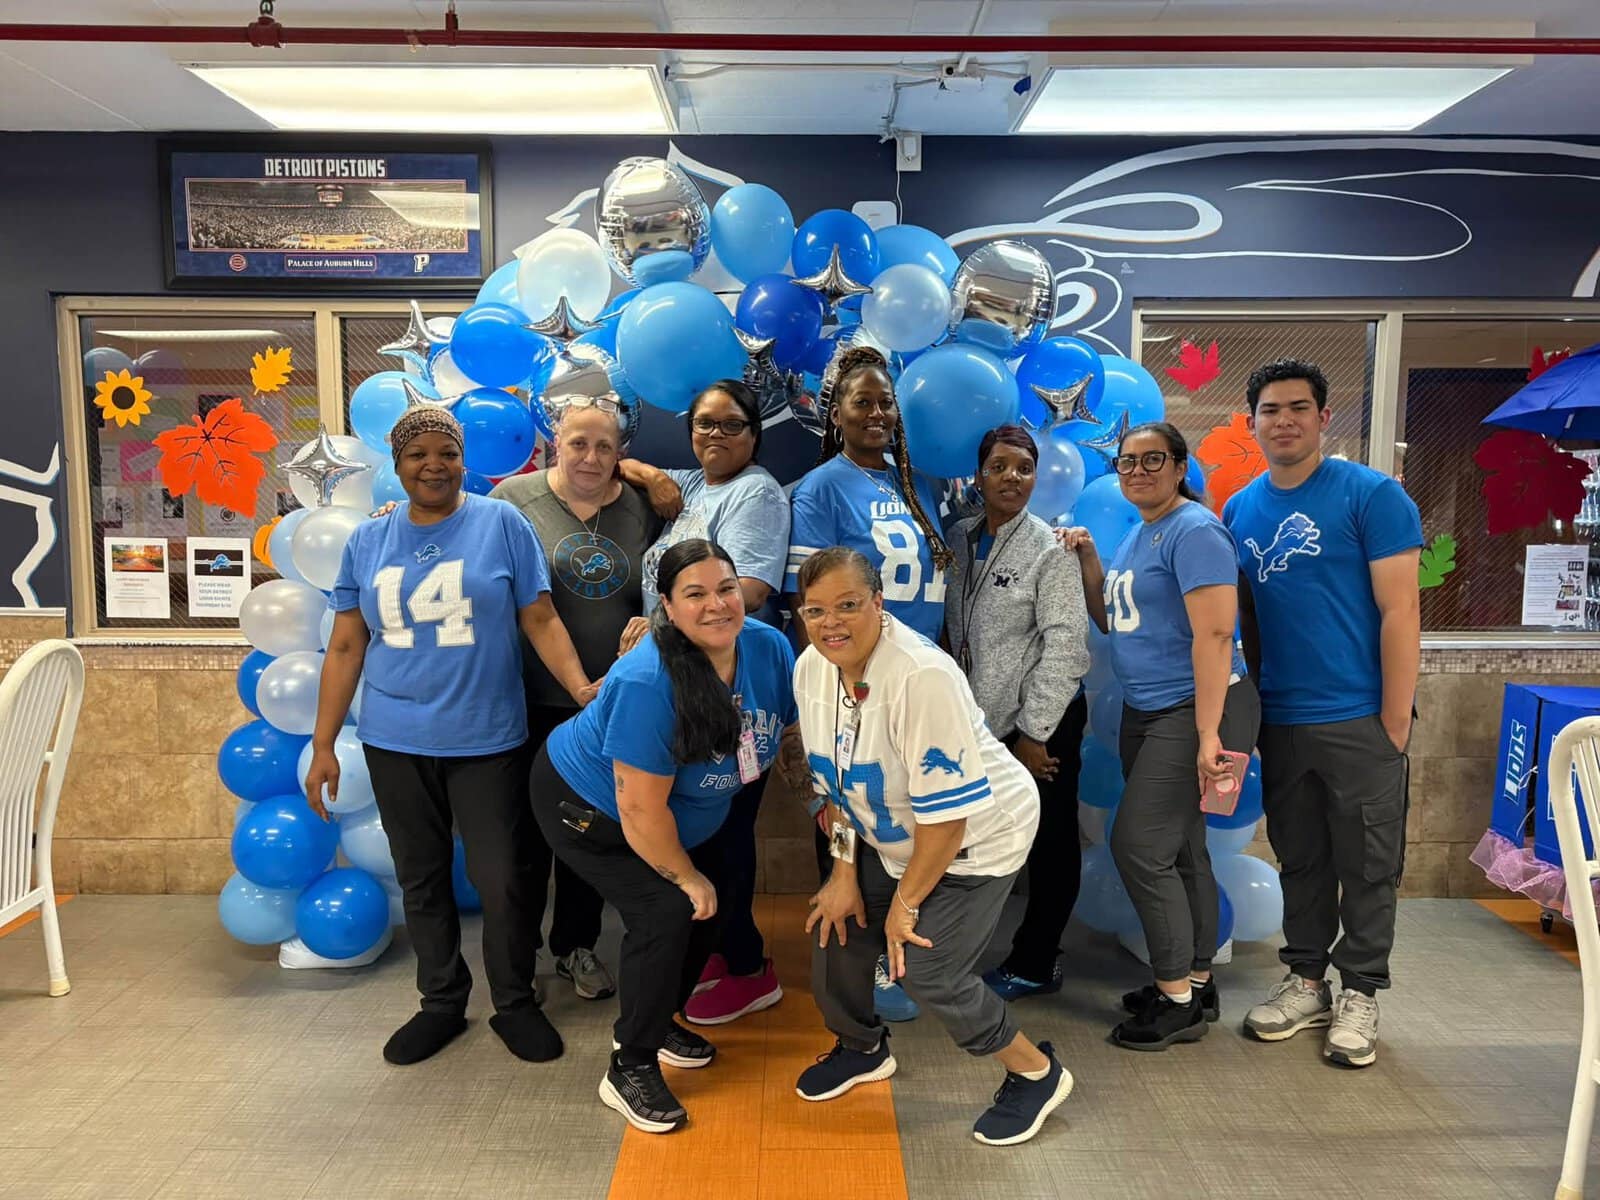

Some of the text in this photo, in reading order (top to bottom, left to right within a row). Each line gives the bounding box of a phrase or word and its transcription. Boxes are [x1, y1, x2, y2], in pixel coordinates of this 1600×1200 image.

[264, 158, 386, 178] DETROIT PISTONS
[287, 259, 314, 267] PALACE
[324, 259, 353, 267] AUBURN
[353, 259, 373, 267] HILLS
[870, 501, 912, 519] LION
[373, 559, 475, 649] 14
